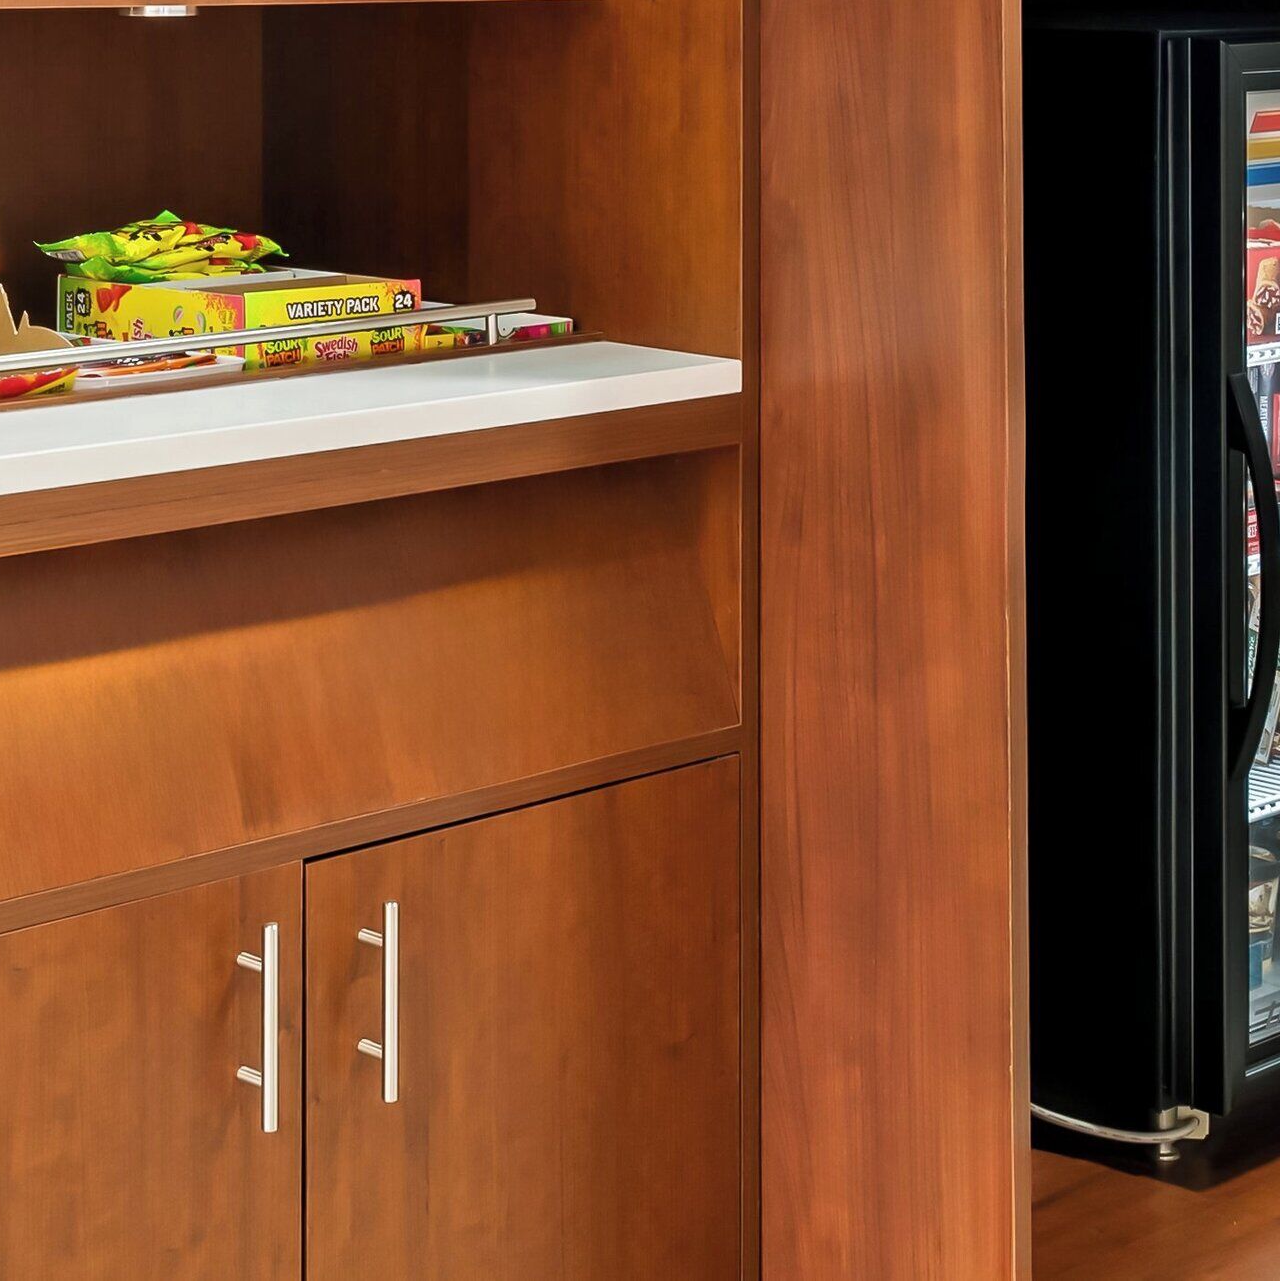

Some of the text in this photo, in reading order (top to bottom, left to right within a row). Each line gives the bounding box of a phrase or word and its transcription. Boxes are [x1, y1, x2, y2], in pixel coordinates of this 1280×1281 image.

[76, 291, 86, 313] 24
[287, 296, 380, 319] VARIETY PACK
[394, 293, 412, 309] 24
[65, 292, 73, 330] PACK
[372, 326, 402, 344] SOUR
[267, 338, 300, 354] SOUR
[315, 335, 359, 357] Swedish
[371, 339, 405, 356] PATCH
[266, 349, 302, 366] PATCH
